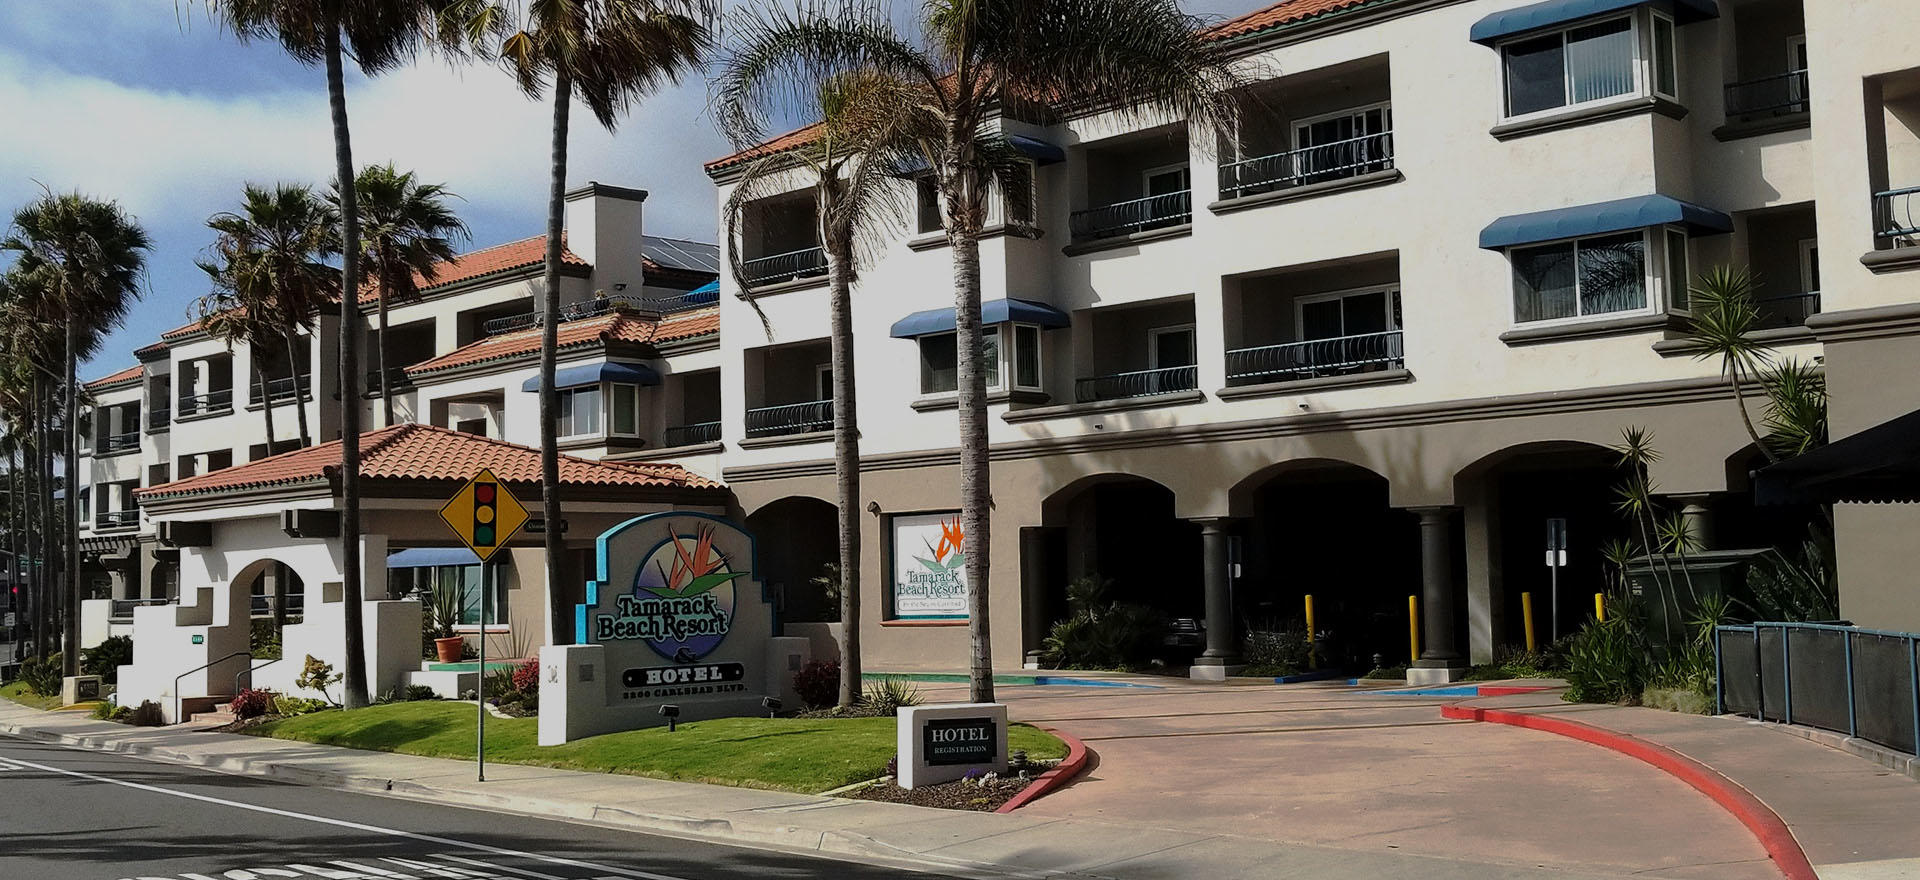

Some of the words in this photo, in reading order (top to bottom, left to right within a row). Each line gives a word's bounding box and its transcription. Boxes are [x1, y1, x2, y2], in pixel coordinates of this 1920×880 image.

[908, 570, 960, 586] Tamarack
[898, 583, 930, 598] Beach
[930, 581, 966, 599] Resort
[618, 595, 717, 618] Tamarack
[600, 615, 662, 641] Beach
[662, 613, 728, 641] Resort
[646, 666, 723, 684] HOTEL
[653, 686, 714, 698] CARLSBAD
[932, 728, 989, 742] HOTEL
[934, 745, 987, 754] REGISTRATION
